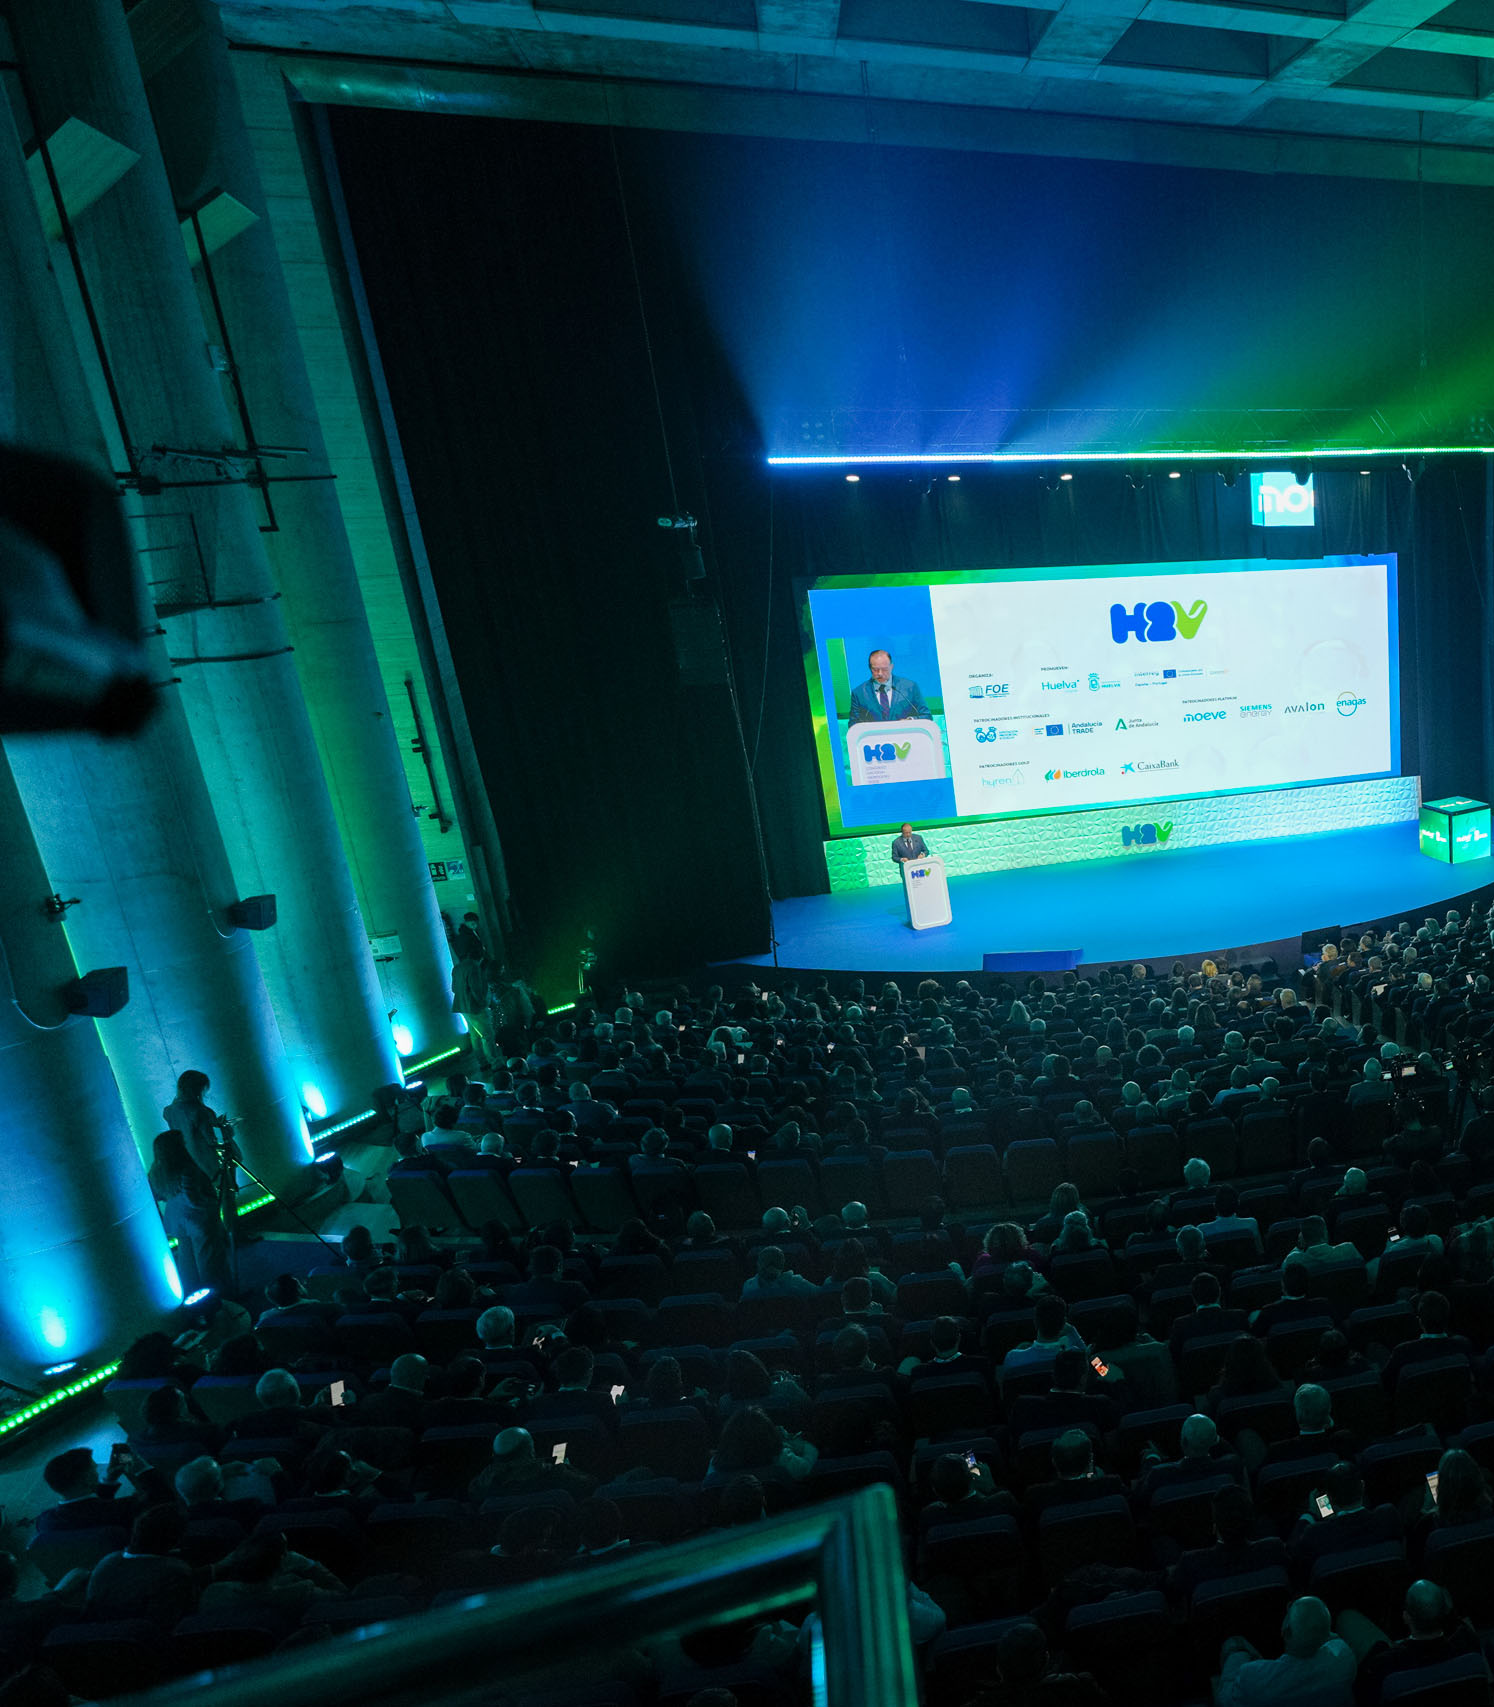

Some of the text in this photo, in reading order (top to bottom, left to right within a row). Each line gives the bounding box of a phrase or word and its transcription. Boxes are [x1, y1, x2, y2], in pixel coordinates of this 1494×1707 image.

[1110, 599, 1208, 644] H2V
[985, 684, 1009, 694] FOE
[1041, 680, 1077, 691] Huelva
[1240, 704, 1273, 712] SIEMENS
[1183, 710, 1227, 722] moeve
[863, 741, 912, 763] H2V
[1121, 820, 1174, 848] H2V
